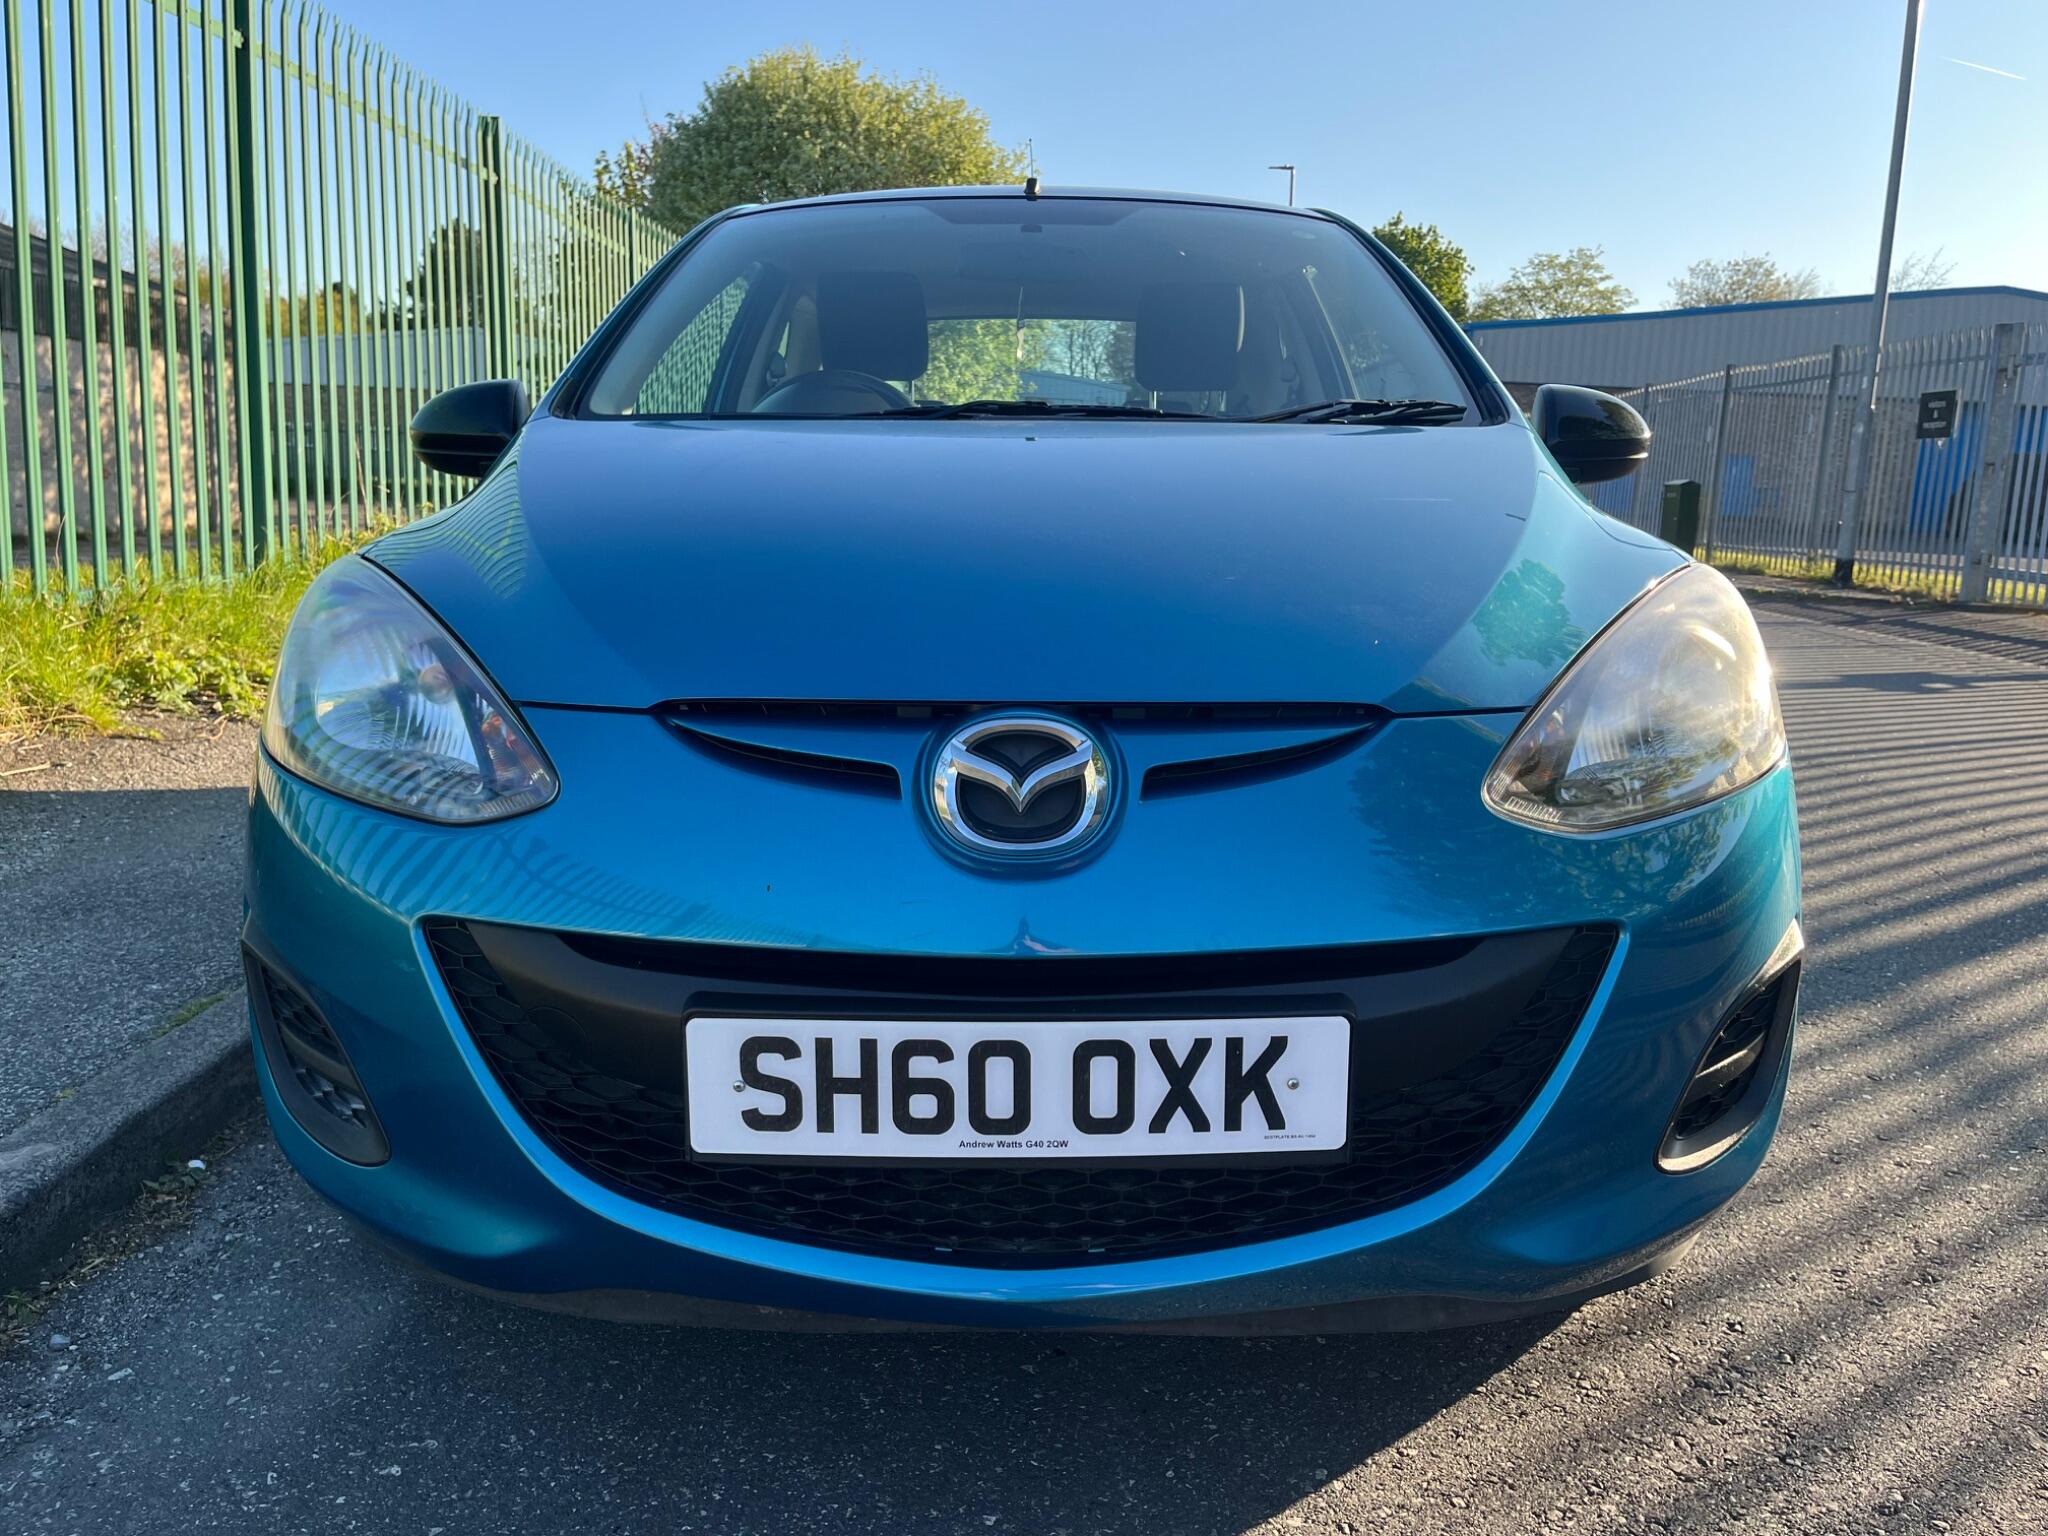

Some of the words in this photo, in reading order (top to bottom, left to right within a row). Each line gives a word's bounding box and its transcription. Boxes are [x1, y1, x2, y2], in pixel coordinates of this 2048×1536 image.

[740, 1036, 1031, 1135] SH60
[1073, 1036, 1288, 1135] OXK
[959, 1140, 995, 1148] Andrew
[996, 1140, 1023, 1148] Watts
[1025, 1140, 1044, 1148] G40
[1046, 1140, 1069, 1148] 2QW
